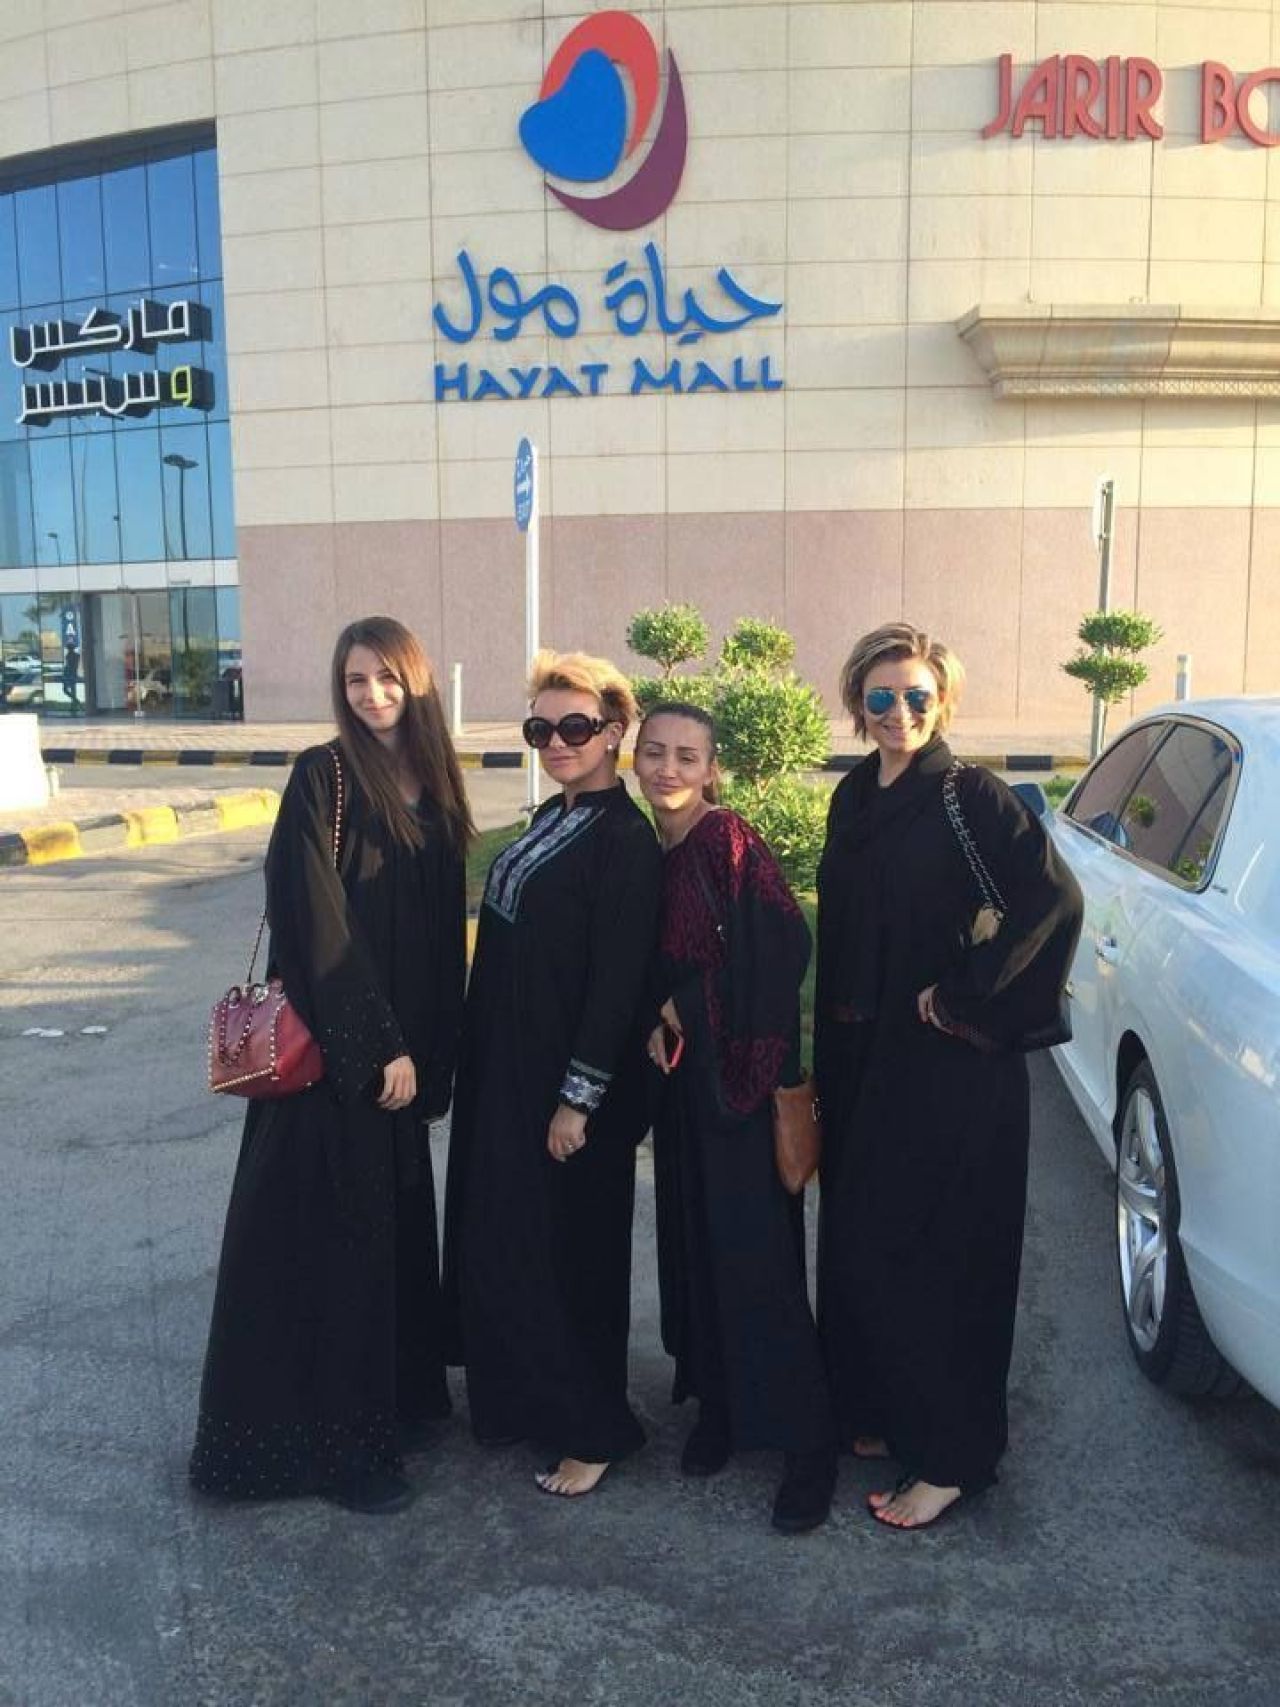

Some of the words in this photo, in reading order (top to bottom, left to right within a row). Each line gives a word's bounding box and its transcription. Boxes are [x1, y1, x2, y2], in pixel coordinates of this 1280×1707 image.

[982, 53, 1163, 139] JARIR
[10, 298, 190, 367] ماركس
[433, 249, 580, 344] مول
[605, 241, 783, 345] حياة
[434, 362, 609, 400] HAYAT
[631, 356, 783, 395] MALL
